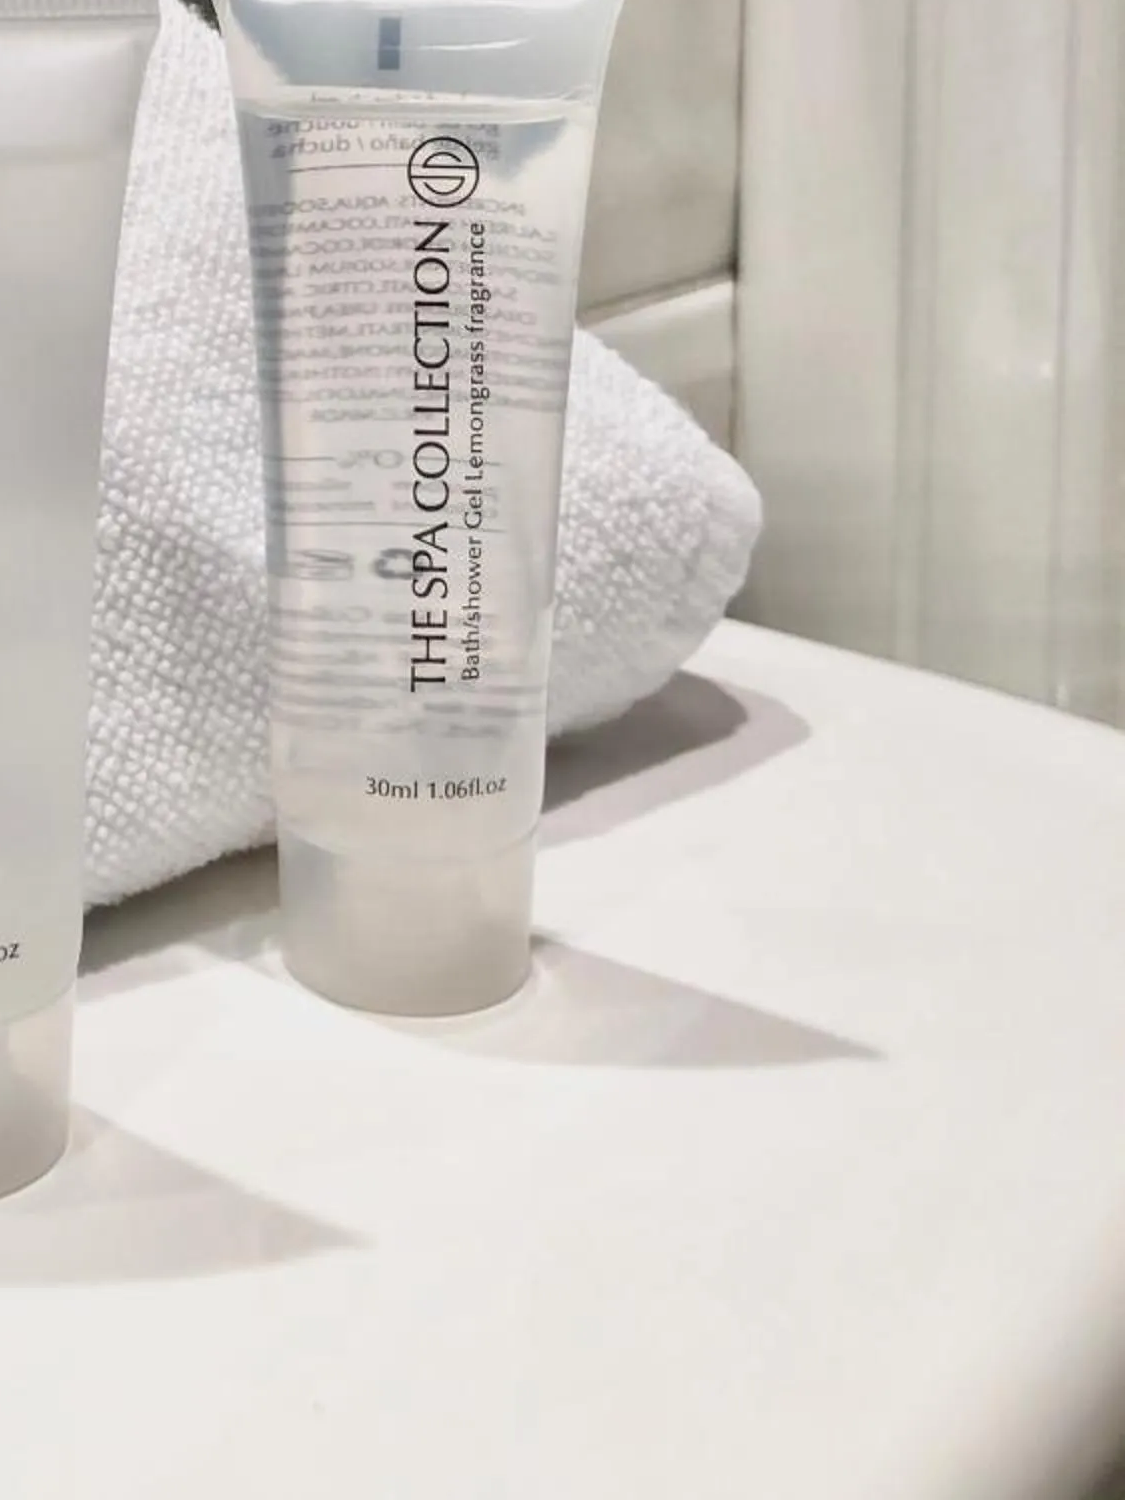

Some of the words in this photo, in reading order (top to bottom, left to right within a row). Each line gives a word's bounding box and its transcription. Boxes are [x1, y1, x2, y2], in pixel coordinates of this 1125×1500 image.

[465, 222, 492, 333] fragrance
[412, 219, 451, 513] COLLECTION
[464, 341, 491, 481] Lemongrass
[462, 486, 484, 529] Gel
[411, 521, 449, 599] SPA
[460, 536, 484, 681] Bath/shower
[410, 609, 448, 692] THE
[364, 775, 419, 799] 30ml
[426, 776, 508, 799] 1.06fl.oz
